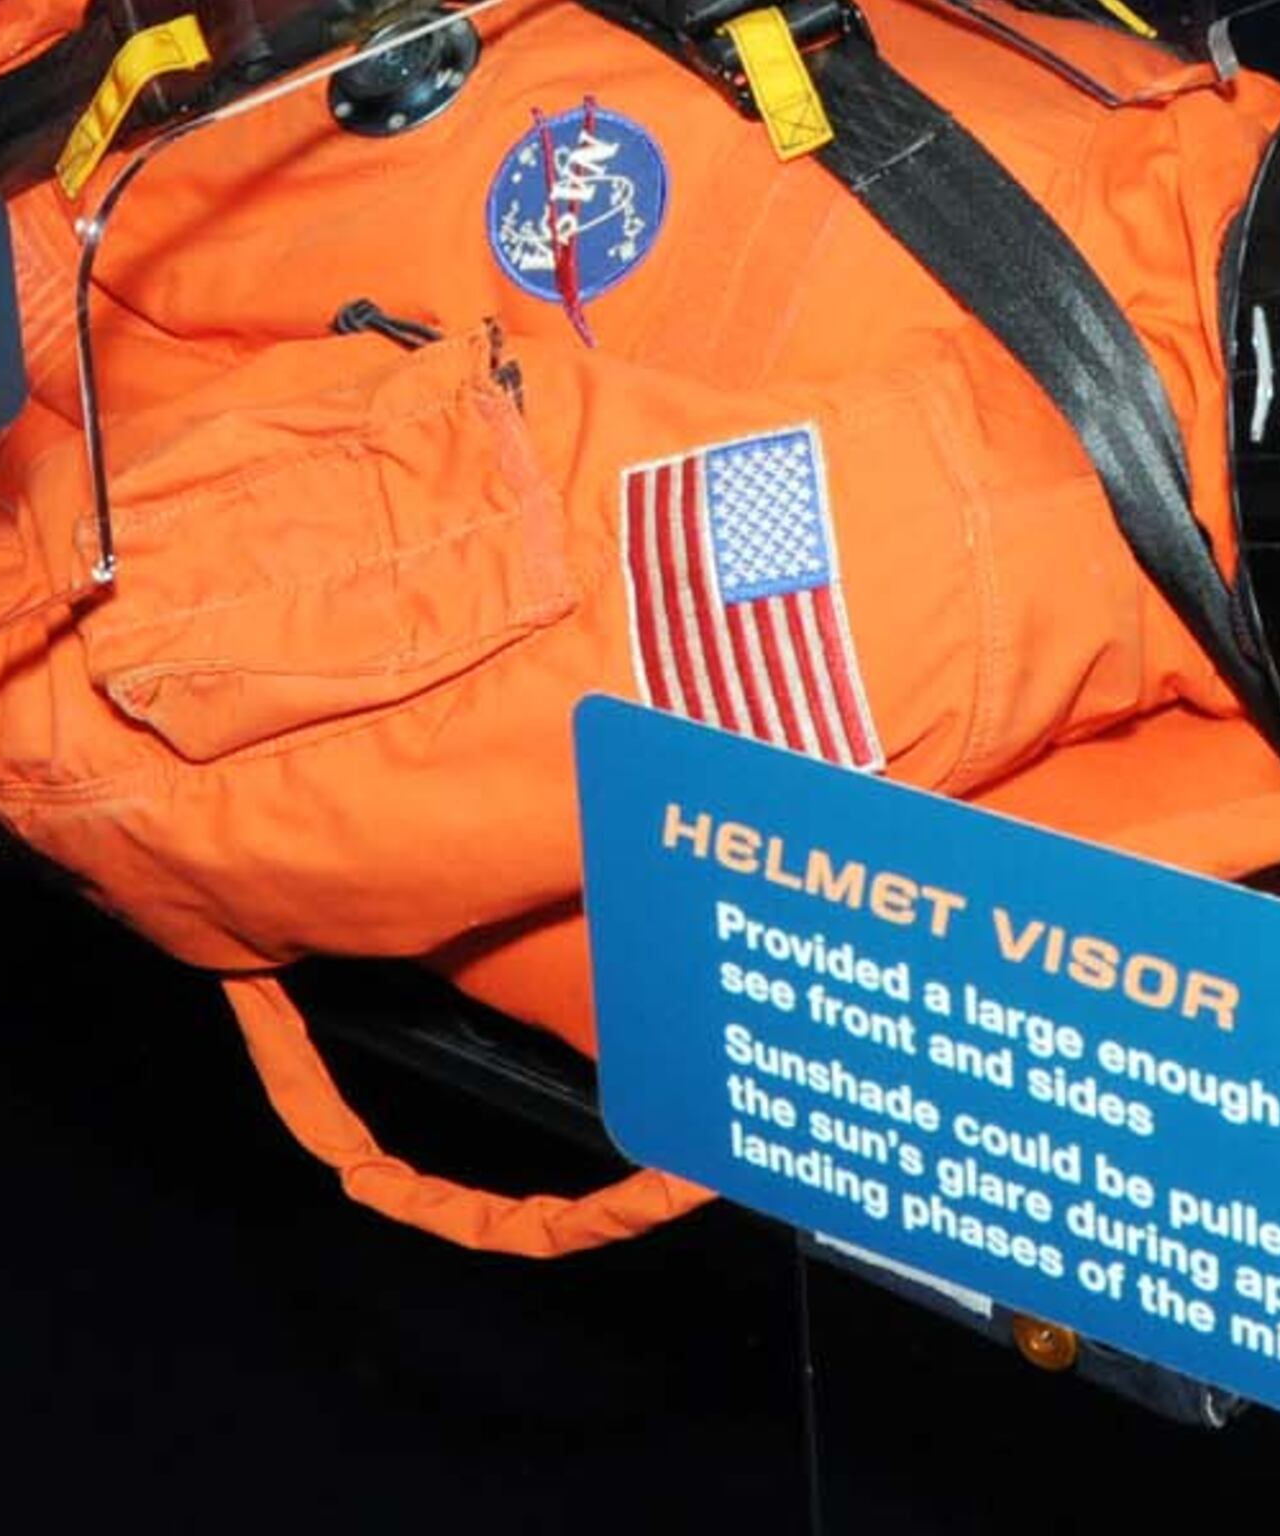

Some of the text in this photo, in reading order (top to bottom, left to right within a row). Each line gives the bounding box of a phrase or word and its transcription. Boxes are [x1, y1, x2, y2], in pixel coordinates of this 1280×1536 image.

[662, 803, 1241, 1031] HELMET VISOR
[716, 901, 911, 1002] Provided
[923, 981, 952, 1016] a
[964, 983, 1085, 1059] large
[1097, 1040, 1280, 1127] enough
[719, 961, 1155, 1136] see front and sides
[724, 1023, 941, 1132] Sunshade
[953, 1113, 1082, 1184] could
[1095, 1153, 1155, 1209] be
[726, 1074, 797, 1129] the
[809, 1110, 924, 1176] sun's
[936, 1157, 1053, 1222] glare
[1065, 1200, 1220, 1292] during
[730, 1120, 890, 1220] landing
[901, 1192, 1065, 1278] phases
[1077, 1259, 1126, 1300] of
[1136, 1273, 1216, 1333] the
